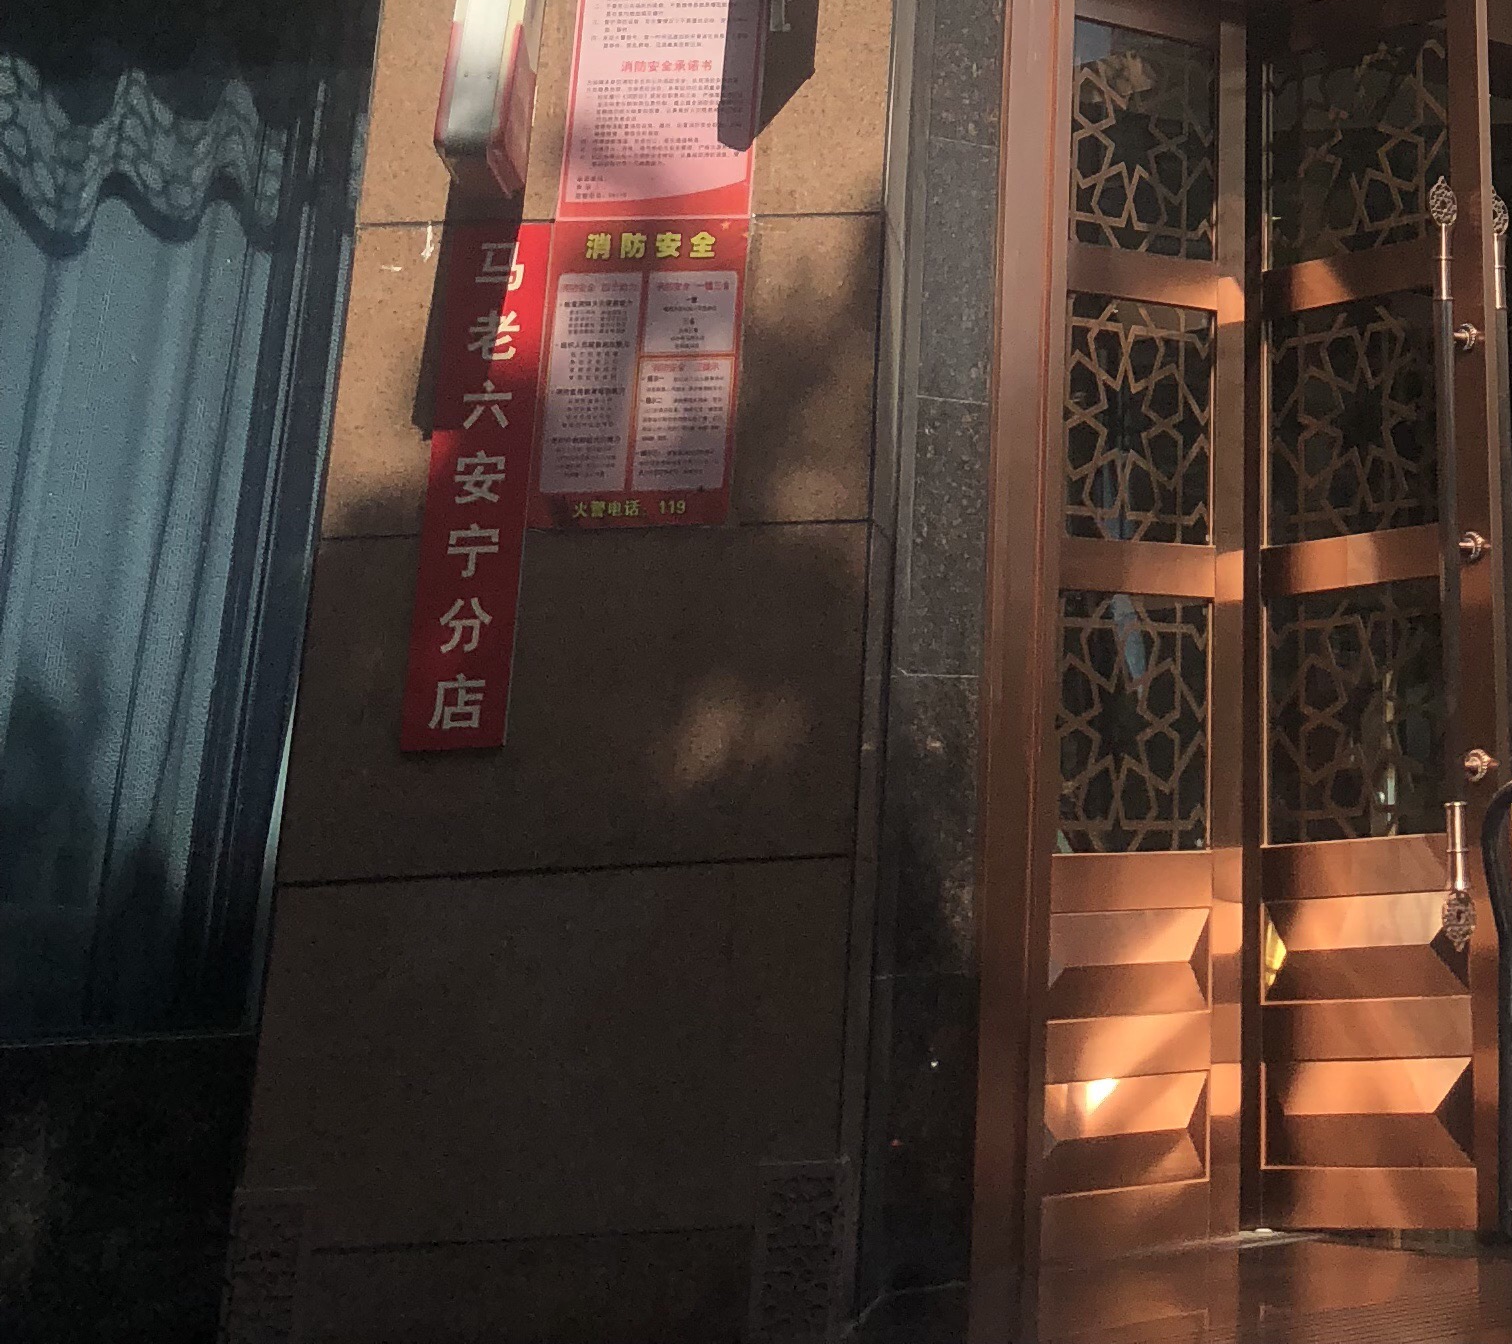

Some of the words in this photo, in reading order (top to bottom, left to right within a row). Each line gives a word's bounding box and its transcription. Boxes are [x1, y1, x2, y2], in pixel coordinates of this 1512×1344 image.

[621, 59, 713, 73] 消防安全承诺书
[585, 231, 716, 260] 消防安全
[427, 242, 525, 731] 马老六安宁分店
[658, 499, 687, 515] 119
